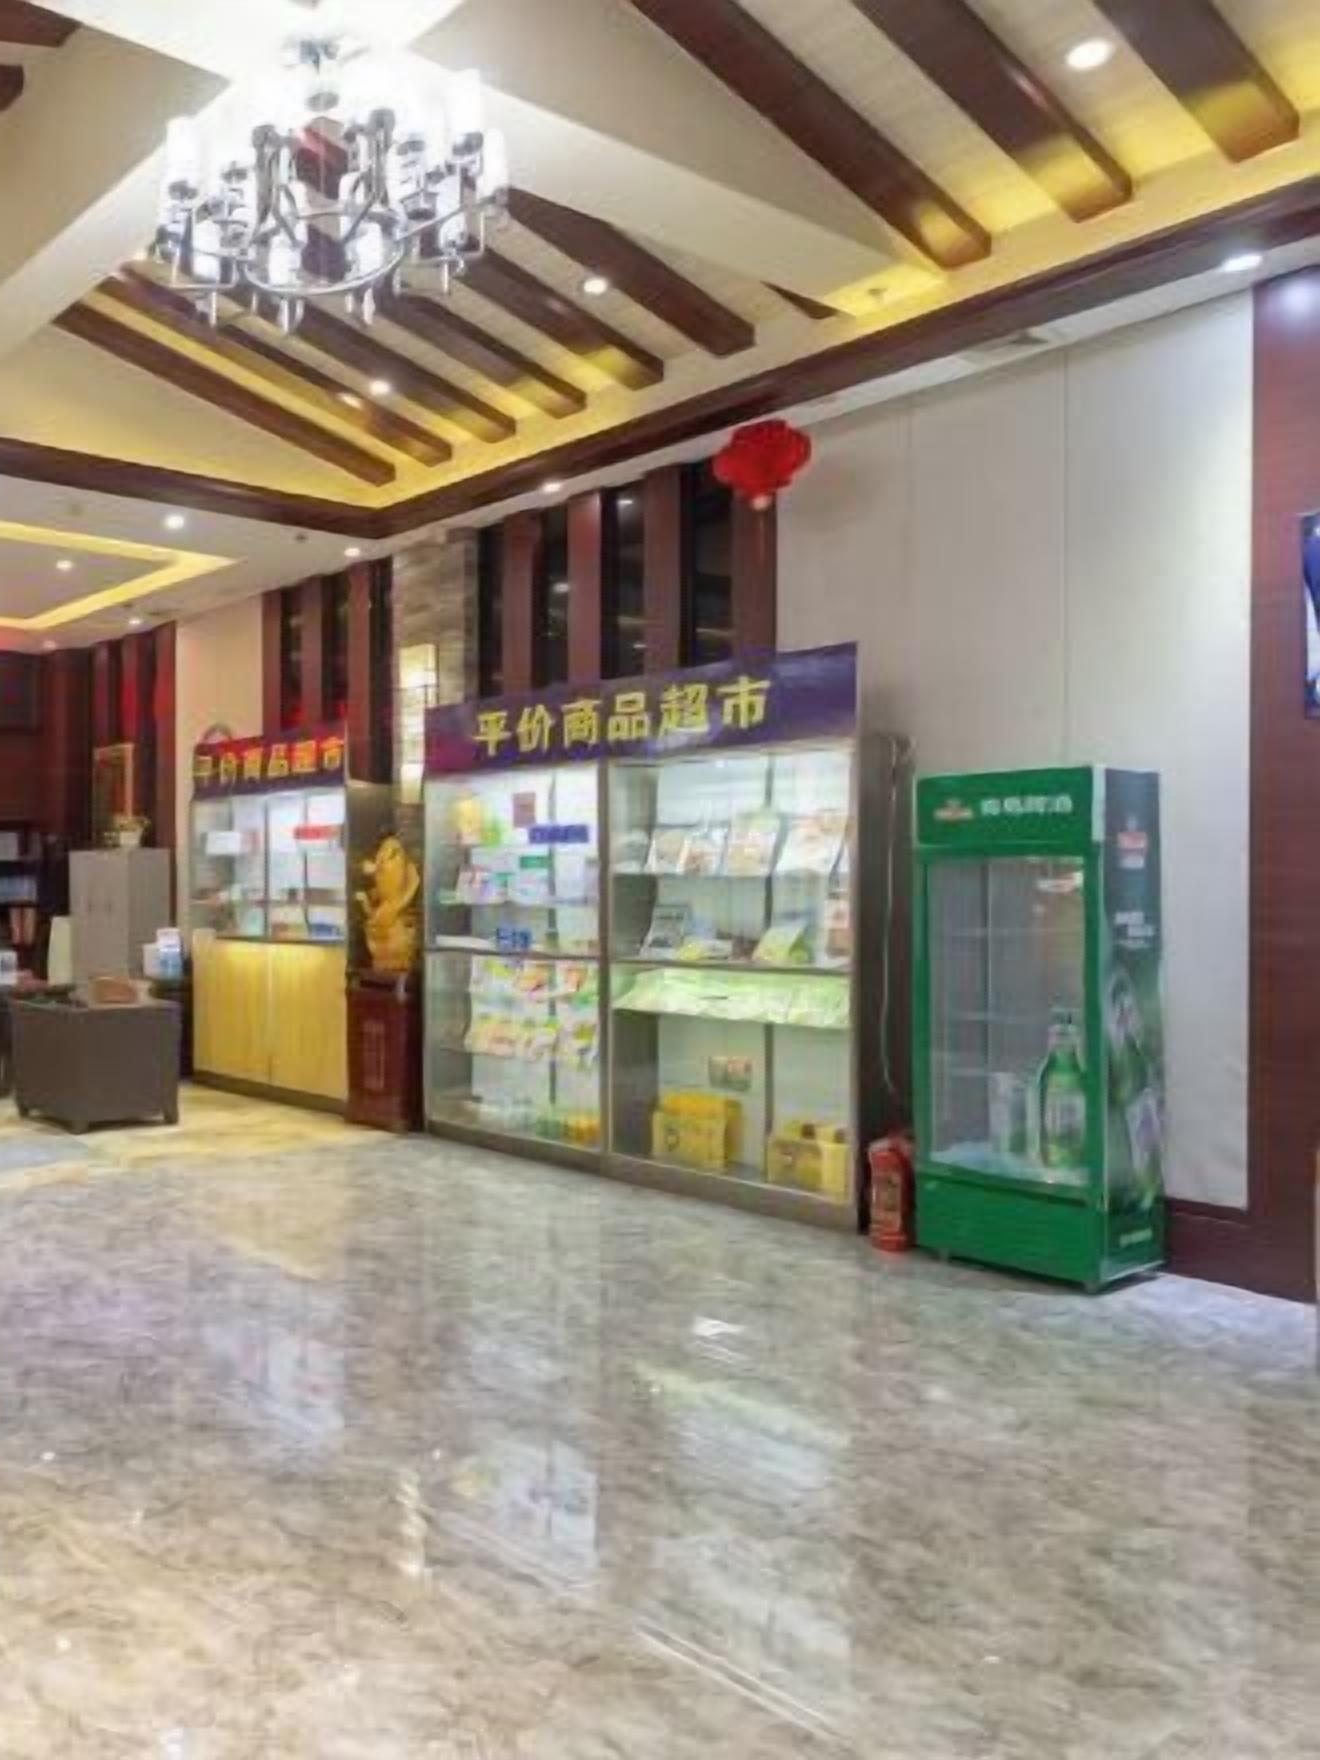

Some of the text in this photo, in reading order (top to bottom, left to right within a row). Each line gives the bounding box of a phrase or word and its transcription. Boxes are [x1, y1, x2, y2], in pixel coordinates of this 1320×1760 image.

[473, 675, 770, 757] 平价商品超市
